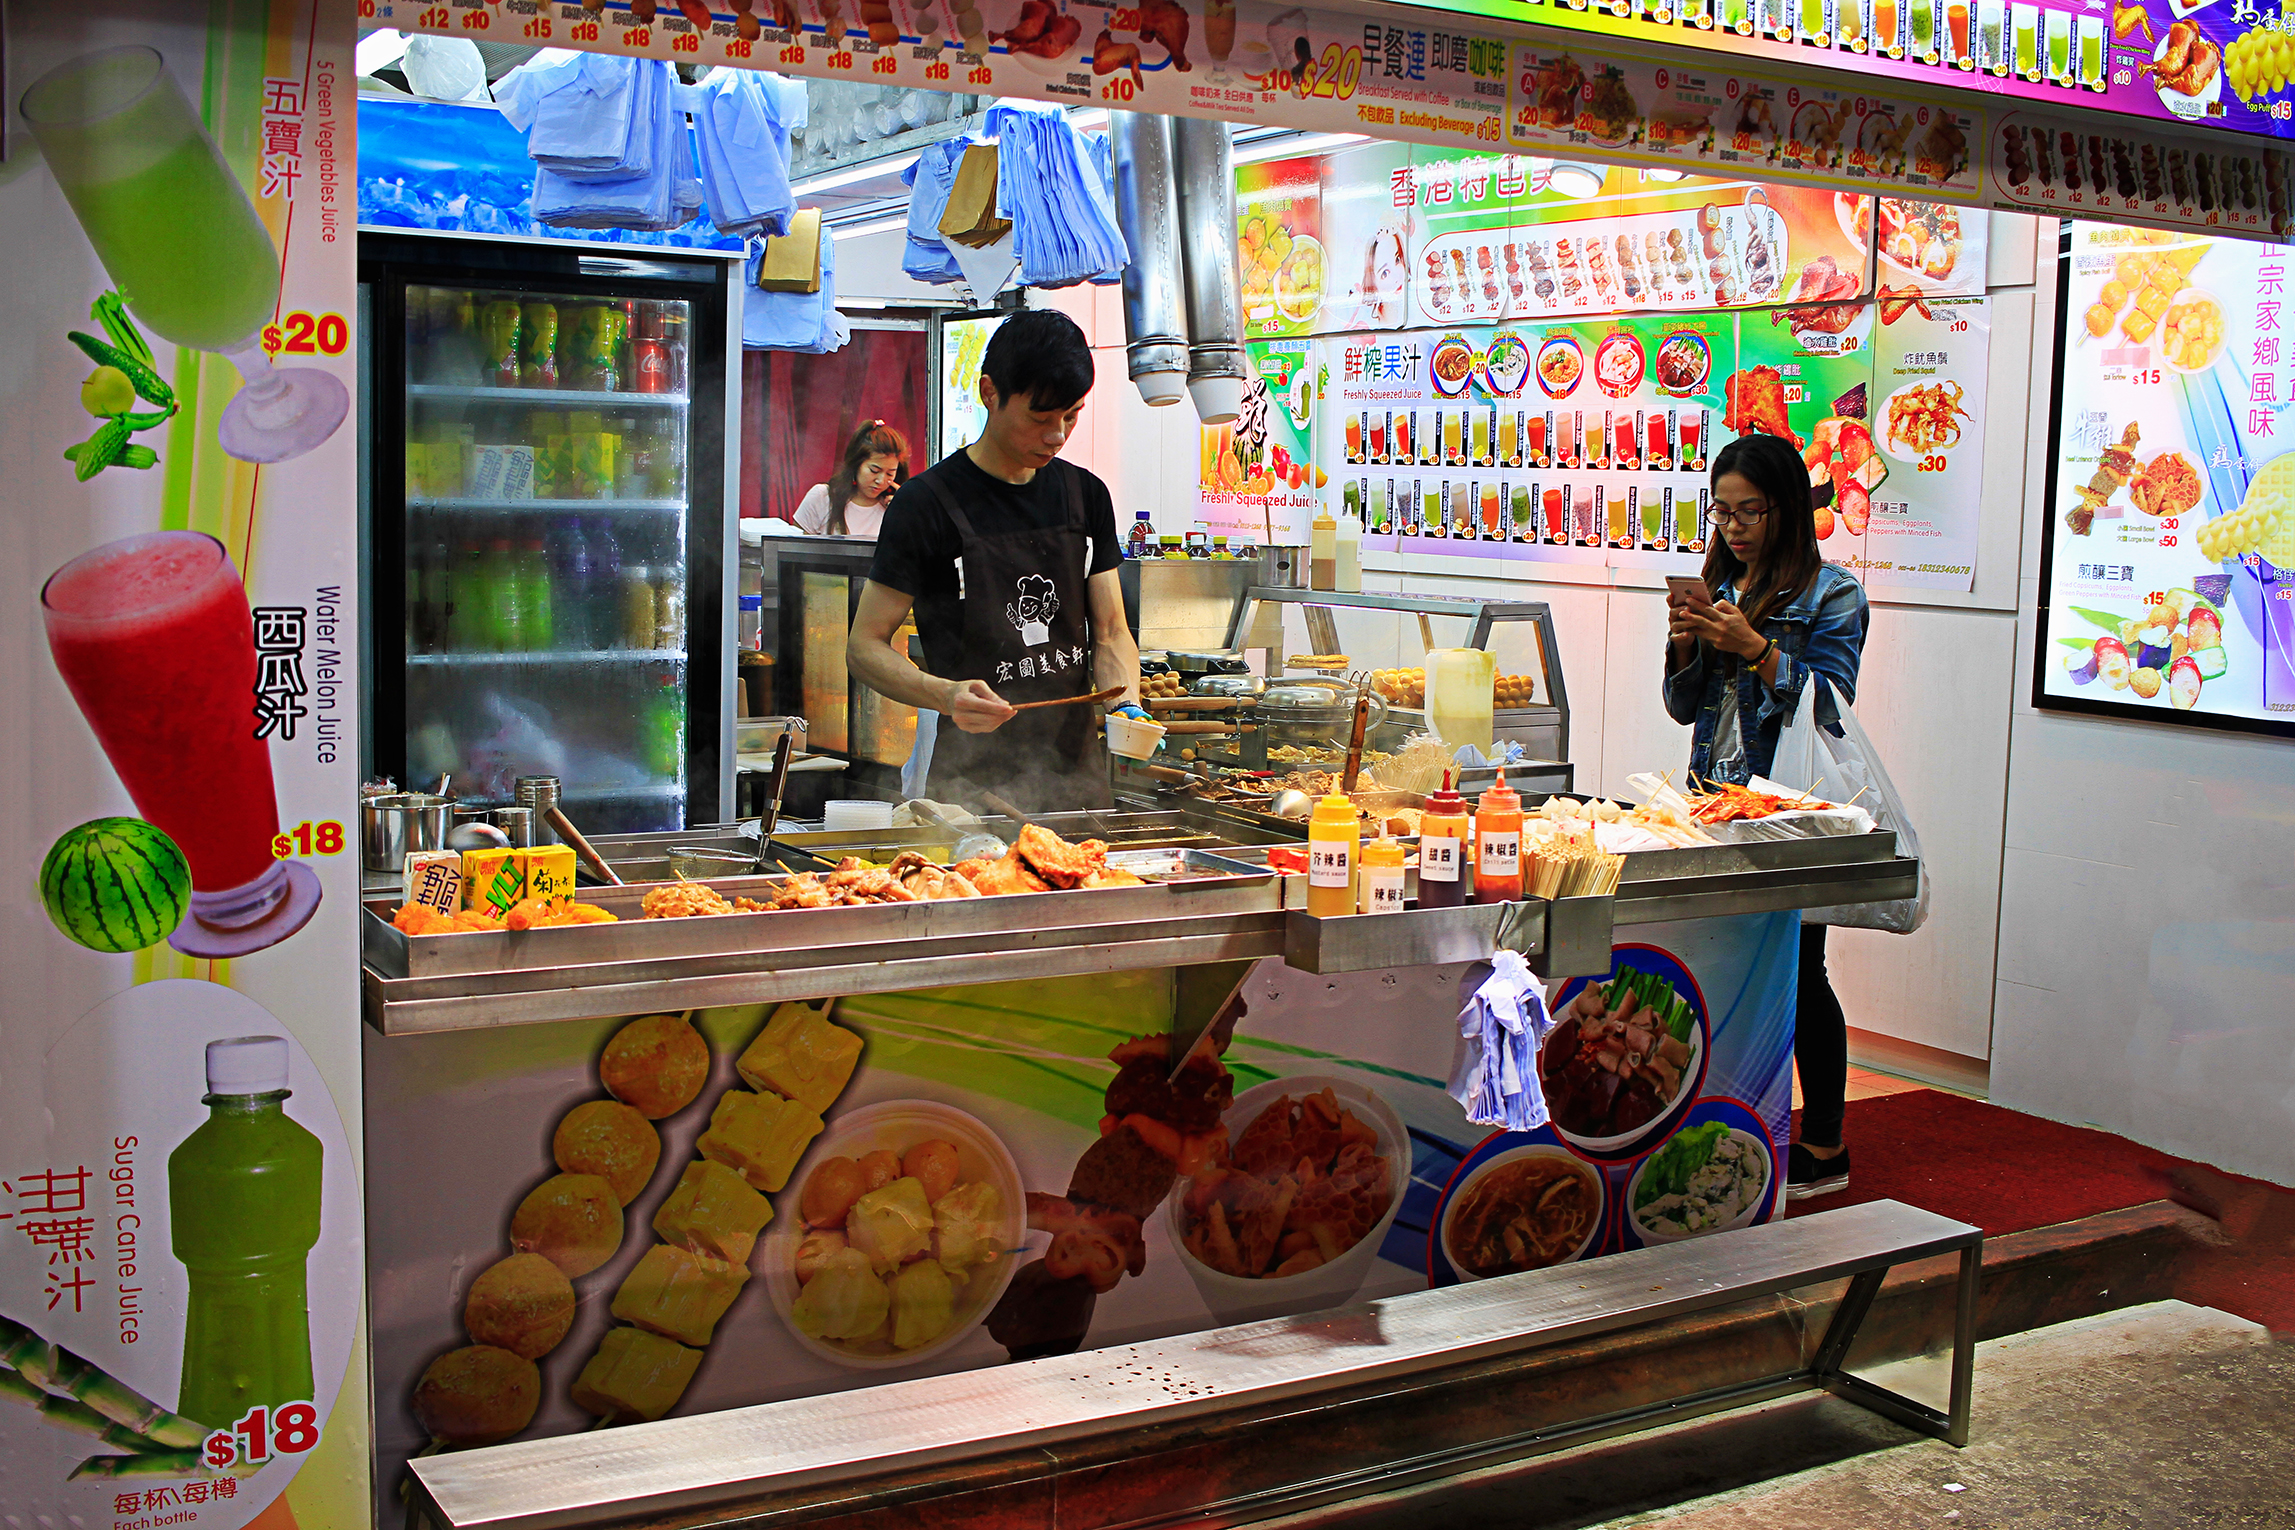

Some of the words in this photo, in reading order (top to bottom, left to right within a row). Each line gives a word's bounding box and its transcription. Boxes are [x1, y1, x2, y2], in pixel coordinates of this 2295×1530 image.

[419, 7, 449, 29] $12
[462, 10, 490, 30] $10
[523, 17, 552, 39] $15
[1109, 8, 1142, 32] $20
[571, 22, 599, 43] $18
[623, 27, 650, 48] $18
[672, 33, 699, 53] $18
[725, 39, 752, 59] $18
[779, 44, 805, 65] $18
[827, 50, 853, 70] $18
[1431, 32, 1506, 80] 即磨咖啡
[317, 61, 335, 71] 5
[872, 55, 897, 75] $18
[925, 60, 950, 81] $18
[1300, 42, 1363, 101] $20
[968, 66, 992, 87] $18
[1261, 69, 1292, 92] $10
[2113, 69, 2131, 85] $10
[316, 73, 335, 118] Green
[1102, 77, 1134, 101] $10
[1358, 82, 1390, 99] Breakfast
[1390, 85, 1413, 101] Served
[1414, 88, 1427, 102] with
[1429, 91, 1450, 106] Coffee
[1518, 105, 1539, 126] $20
[2246, 100, 2257, 113] Egg
[2271, 100, 2292, 120] $15
[1357, 104, 1395, 125] 不包飲品
[1400, 111, 1436, 132] Excluding
[1438, 115, 1475, 136] Beverage
[1477, 116, 1501, 141] $15
[1573, 112, 1595, 132] $20
[263, 78, 302, 199] 五寶汁
[1649, 121, 1667, 140] $18
[1732, 133, 1750, 152] $20
[1784, 139, 1801, 158] $20
[315, 120, 337, 204] Vegetables
[1848, 147, 1866, 166] $20
[1915, 157, 1932, 175] $25
[321, 205, 336, 243] Juice
[262, 313, 348, 354] $20
[1263, 320, 1279, 332] $15
[1950, 320, 1968, 332] $10
[1841, 337, 1858, 351] $20
[1344, 343, 1422, 383] 鮮榨果汁
[1472, 363, 1485, 374] $20
[2133, 369, 2160, 384] $15
[1344, 389, 1368, 401] Freshly
[1369, 389, 1402, 402] Squeezed
[1403, 389, 1422, 399] Juice
[1457, 390, 1470, 400] $15
[1509, 390, 1521, 400] $15
[1552, 389, 1567, 400] $18
[1614, 386, 1629, 398] $12
[1691, 385, 1708, 395] $30
[1784, 388, 1800, 402] $20
[1918, 455, 1946, 472] $30
[1236, 492, 1286, 508] Squeezed
[2160, 518, 2178, 530] $30
[2158, 536, 2178, 547] $50
[2244, 556, 2260, 567] $15
[2076, 591, 2098, 599] Peppers
[2144, 591, 2164, 605] $15
[2276, 590, 2292, 600] $15
[315, 586, 341, 645] Water
[252, 607, 308, 741] 西瓜汁
[996, 646, 1084, 684] 宏圖美食軒
[316, 649, 342, 711] Melon
[316, 713, 342, 764] Juice
[272, 821, 345, 858] $18
[1484, 842, 1517, 856] 辣椒醬
[1314, 852, 1346, 867] 芥辣醬
[1429, 848, 1450, 862] 甜醬
[486, 855, 523, 911] VLT
[109, 1136, 138, 1208] Sugar
[115, 1213, 141, 1278] Cane
[118, 1284, 144, 1345] Juice
[204, 1403, 320, 1468] $18
[154, 1510, 198, 1529] bottle
